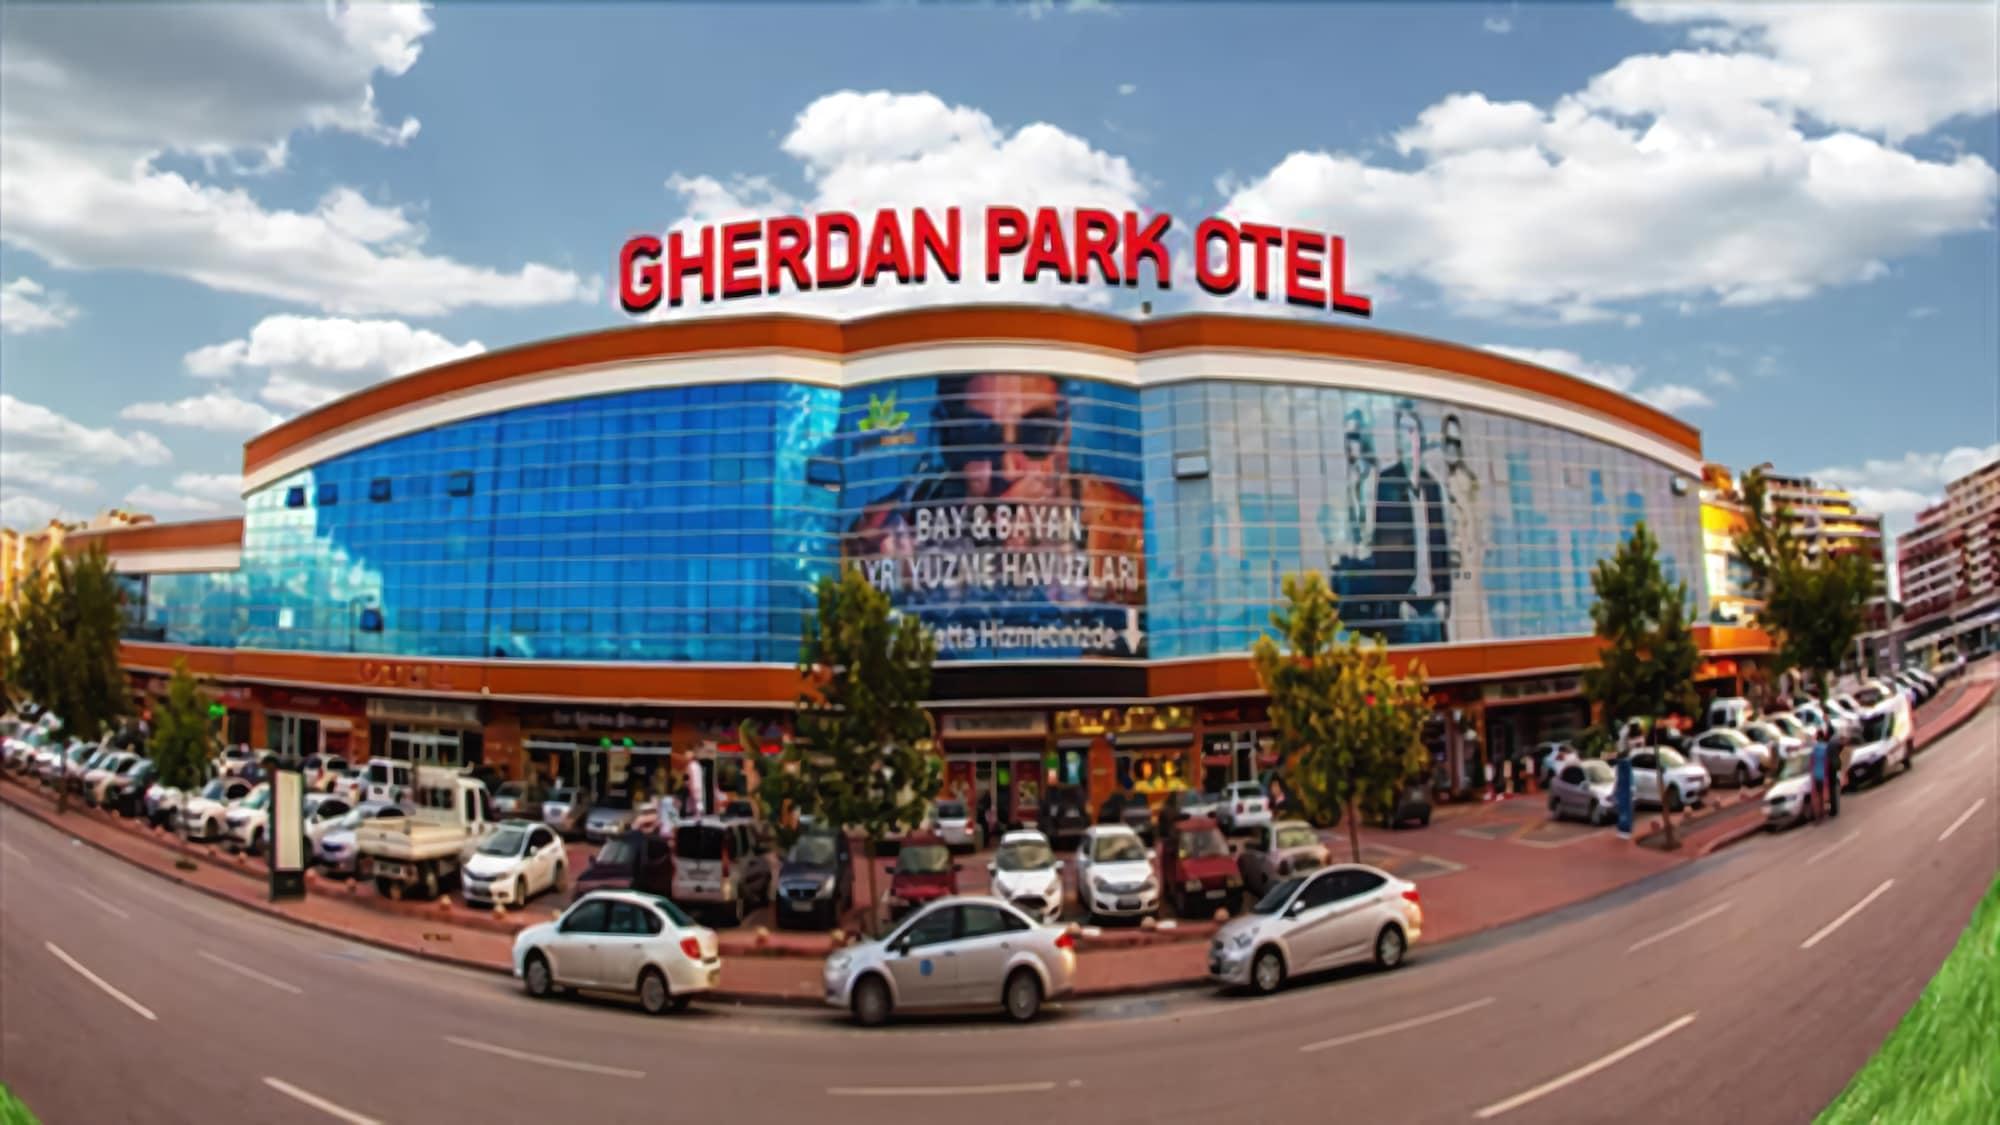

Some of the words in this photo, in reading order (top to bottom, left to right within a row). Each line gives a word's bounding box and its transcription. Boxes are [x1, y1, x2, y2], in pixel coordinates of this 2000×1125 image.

[619, 206, 960, 314] GHERDAN
[985, 206, 1171, 290] PARK
[1195, 217, 1372, 318] OTEL
[916, 506, 967, 542] BAY
[971, 504, 992, 541] &
[996, 504, 1082, 541] BAYAN
